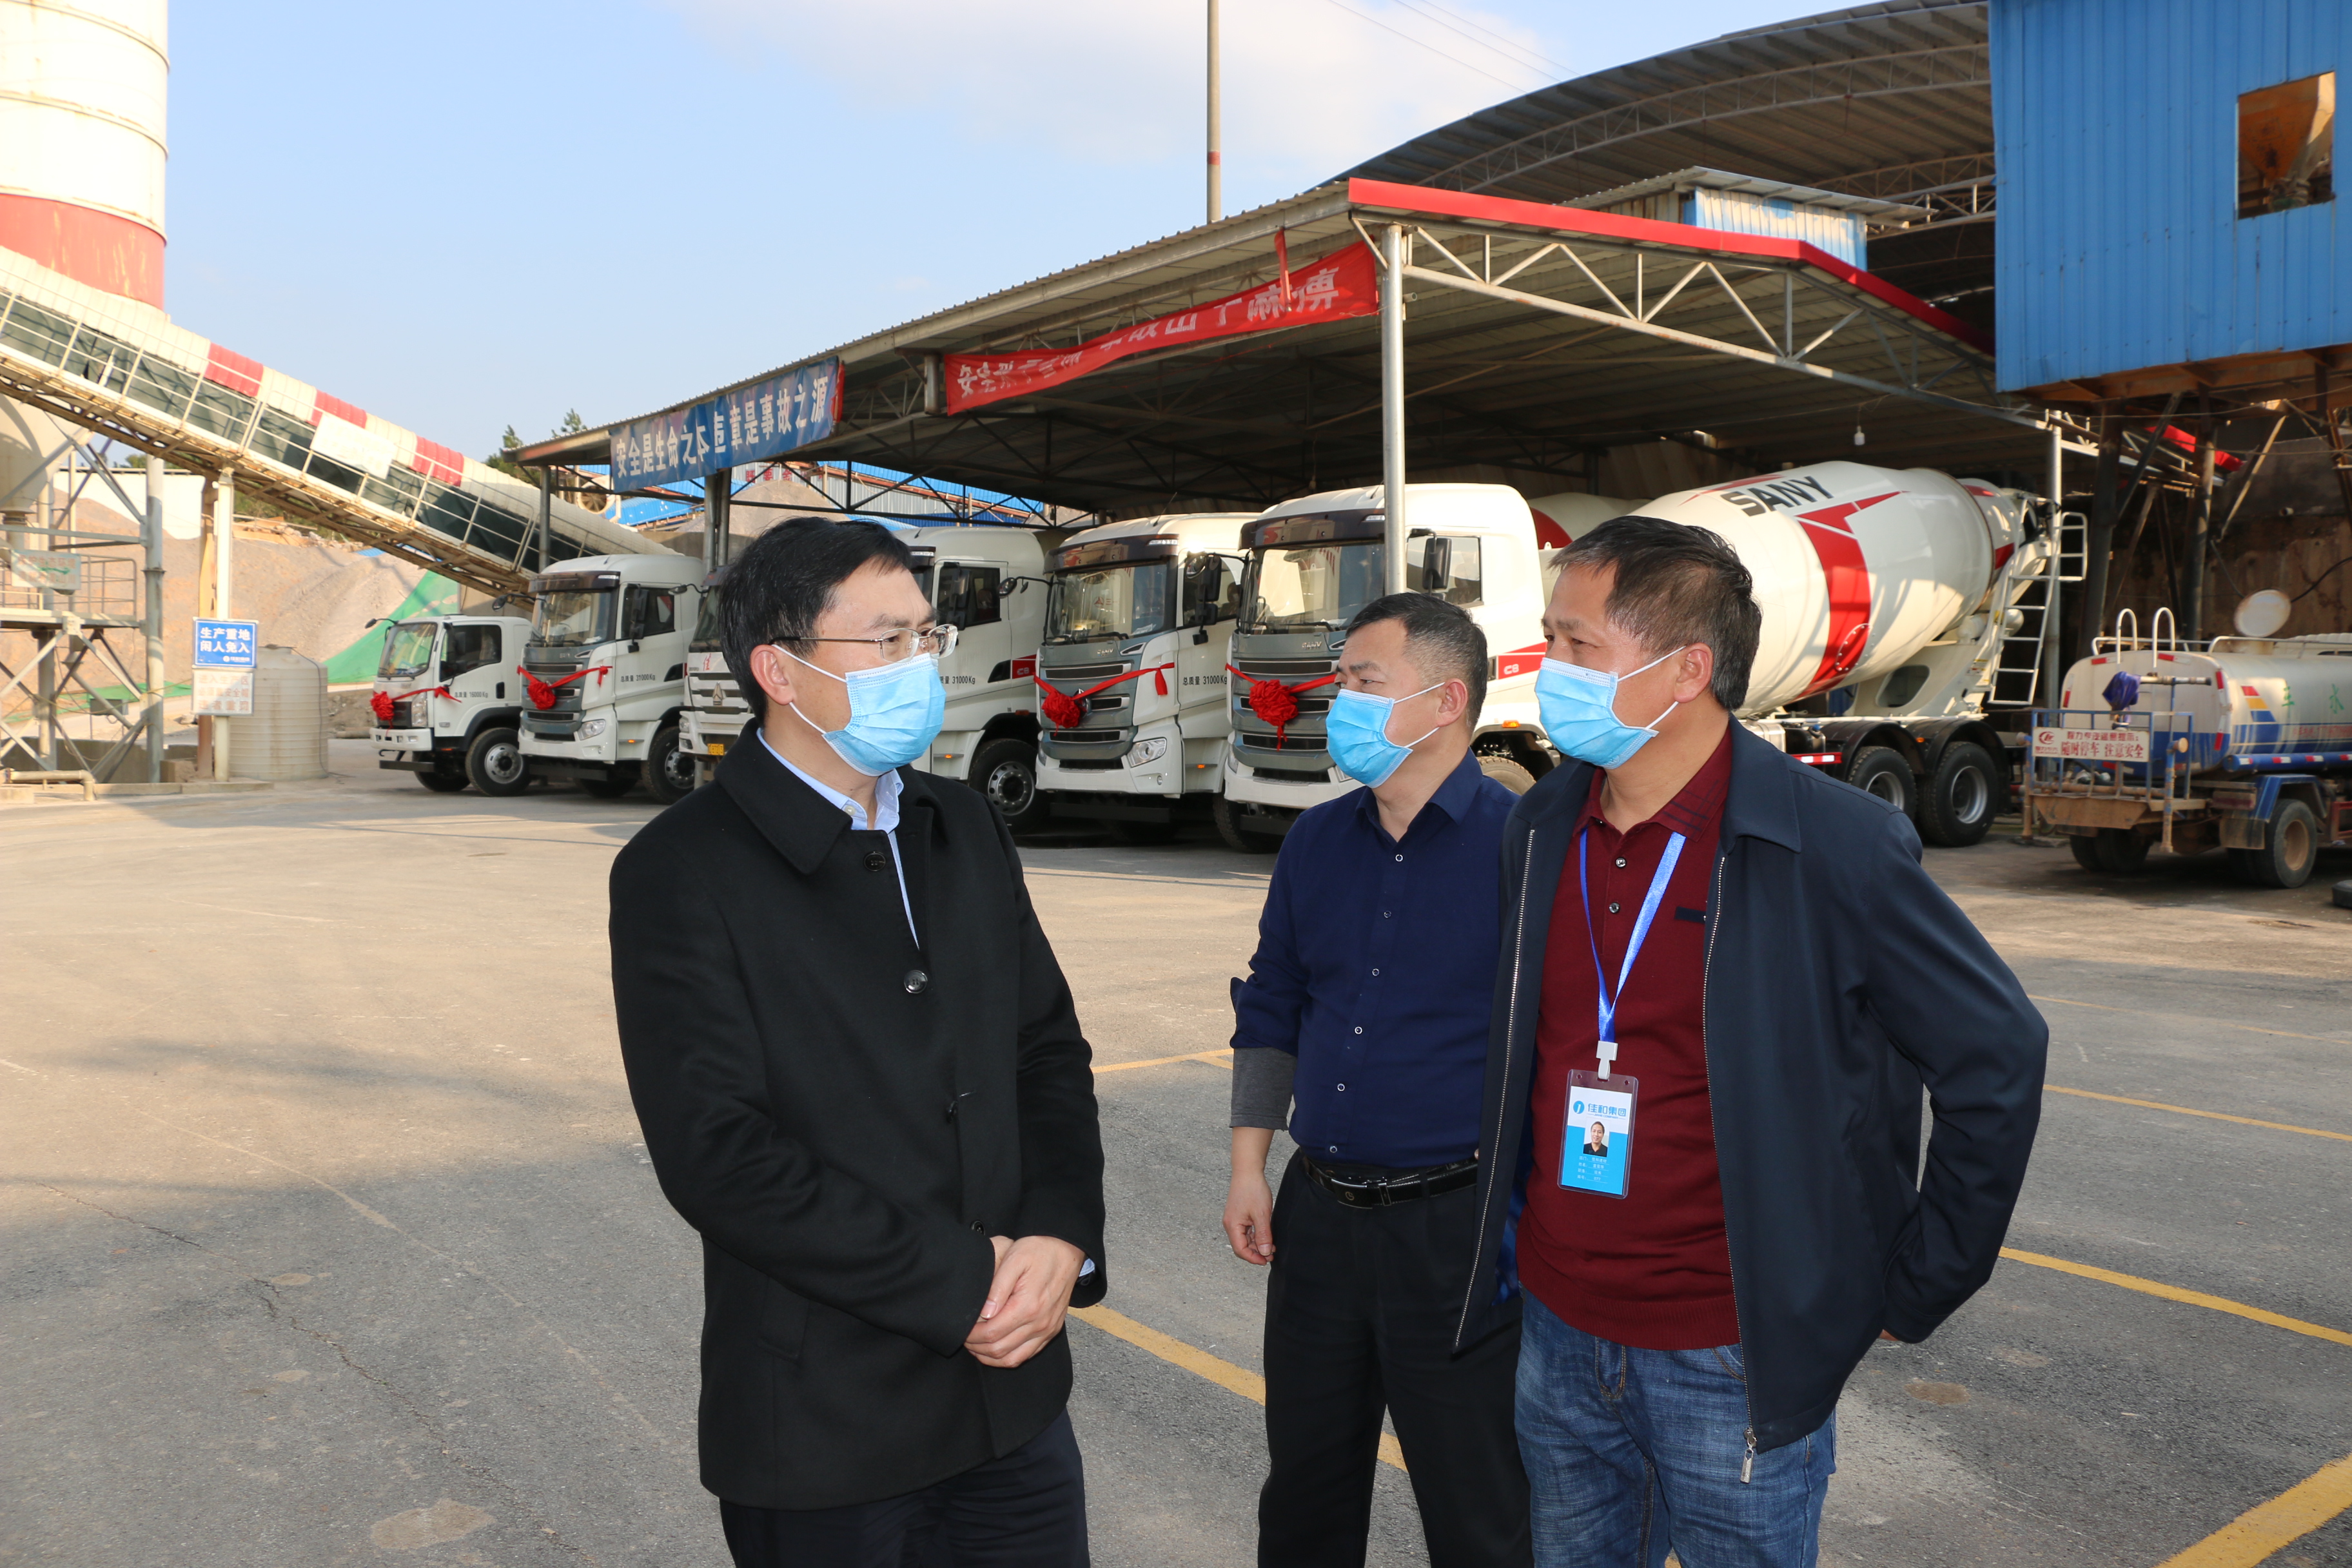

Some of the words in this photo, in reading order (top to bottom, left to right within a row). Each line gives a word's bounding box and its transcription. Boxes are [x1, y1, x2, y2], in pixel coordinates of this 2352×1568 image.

[1720, 476, 1834, 517] SANY
[200, 627, 251, 641] 生产重地
[200, 640, 250, 653] 闲人免入
[1503, 663, 1520, 675] C8
[199, 674, 249, 685] 进入生产区
[952, 676, 975, 684] 31000Kg
[1182, 676, 1200, 685] 总质量
[1203, 675, 1228, 685] 31000Kg
[2061, 741, 2100, 757] 随时停车
[2104, 743, 2144, 759] 注意安全
[1588, 1103, 1627, 1117] 佳和集团
